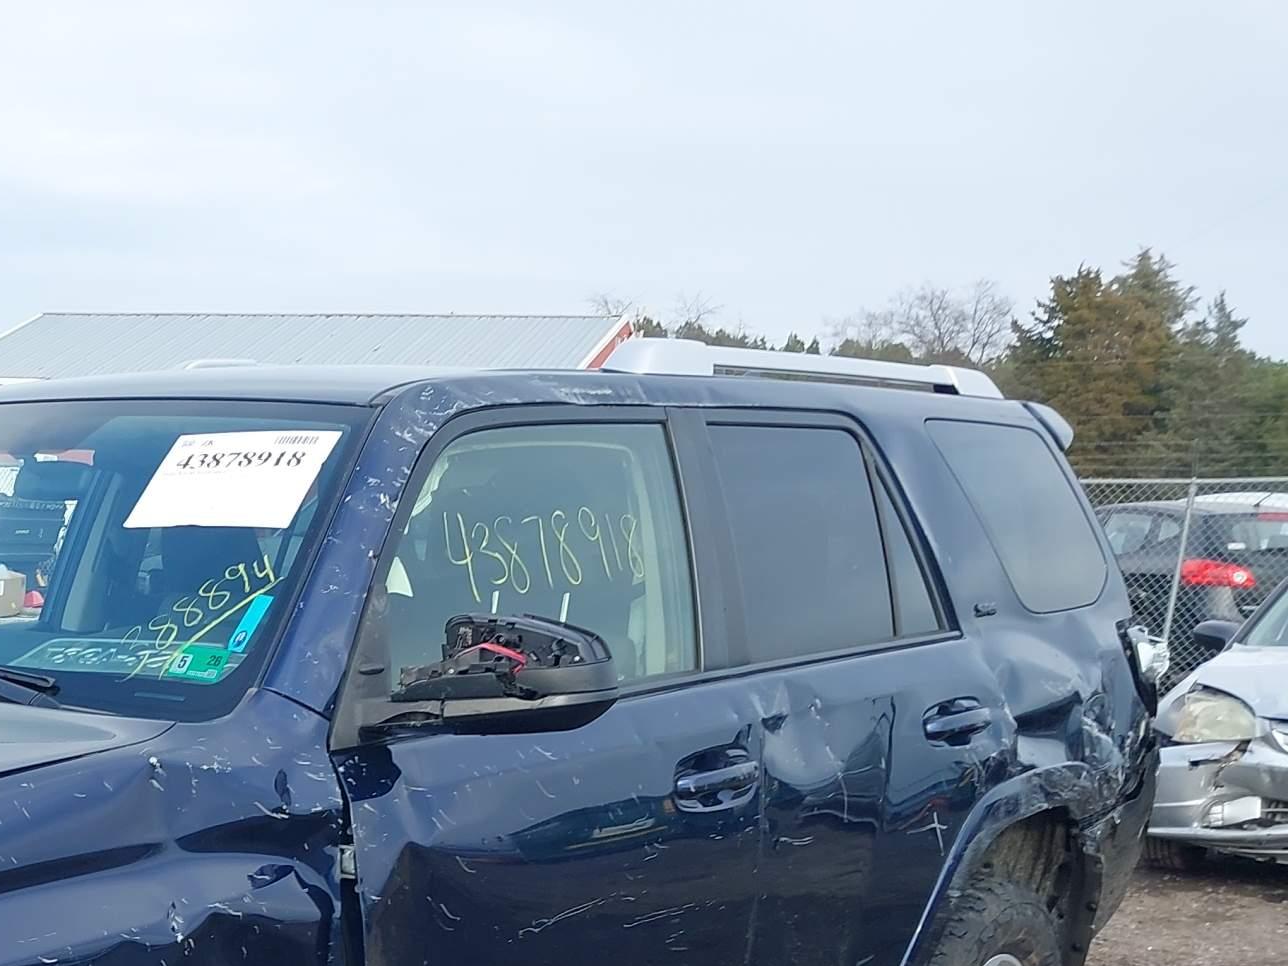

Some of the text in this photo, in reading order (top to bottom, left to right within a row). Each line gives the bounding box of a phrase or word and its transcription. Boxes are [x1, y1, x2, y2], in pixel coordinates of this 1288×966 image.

[176, 450, 307, 470] 43878918
[443, 506, 646, 603] 43878918
[177, 655, 190, 669] 5
